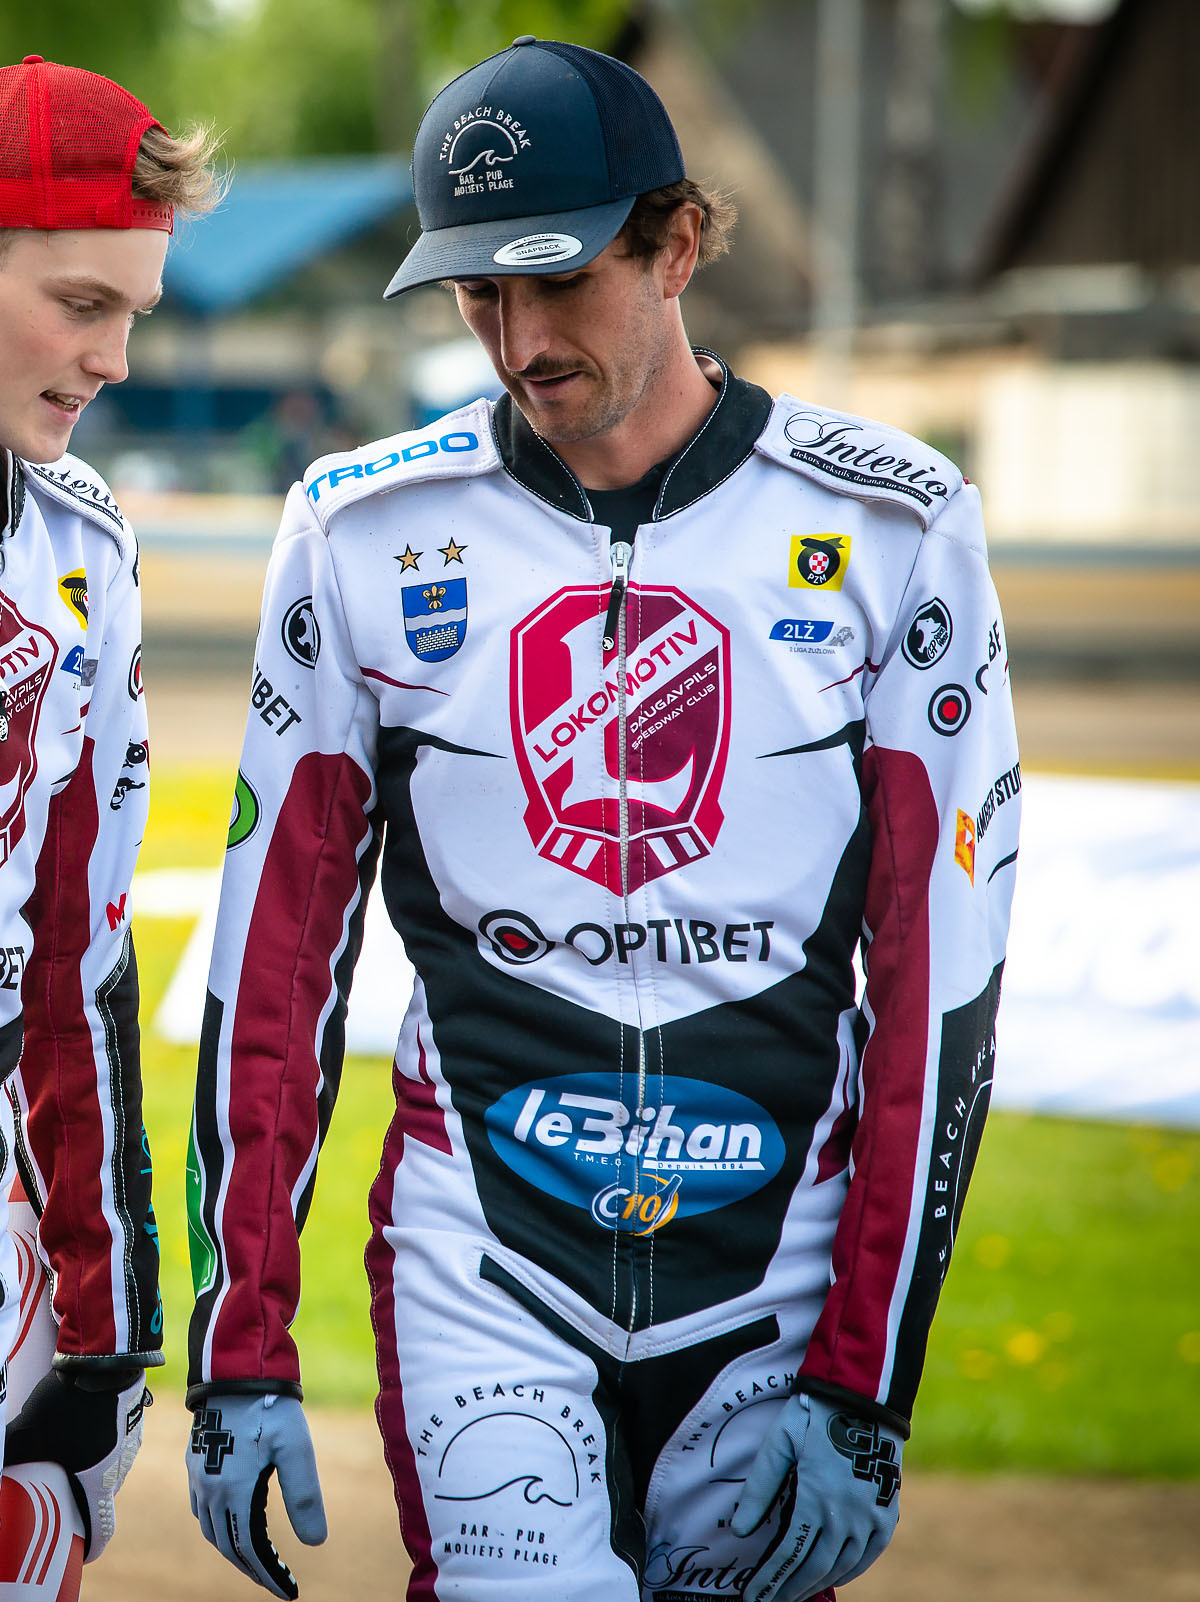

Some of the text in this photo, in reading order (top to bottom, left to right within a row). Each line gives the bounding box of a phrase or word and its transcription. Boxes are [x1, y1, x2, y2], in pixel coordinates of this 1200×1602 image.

[439, 106, 532, 161] THE BEACH BREAK
[454, 179, 515, 197] MOLIETS PLAGE
[459, 173, 475, 186] BAR
[486, 169, 503, 182] PUB
[515, 243, 561, 256] SNAPBACK
[306, 431, 479, 503] TRODO
[783, 411, 949, 501] Interio
[33, 465, 126, 523] nterio
[807, 572, 827, 584] PZM
[15, 692, 36, 713] CLUB
[533, 619, 697, 763] LOKOMOTIV
[629, 662, 717, 734] DAUGAVPILS
[631, 683, 716, 750] SPEEDWAY CLUB
[976, 787, 996, 843] AMBER
[566, 919, 775, 967] OPTIBET
[934, 1035, 996, 1218] BEACH BREA
[417, 1383, 602, 1483] THE BEACH BREAK
[682, 1373, 795, 1453] THE BEACH
[444, 1542, 559, 1566] MOLIETS PLAGE
[461, 1523, 489, 1538] BAR
[516, 1528, 546, 1544] PUB
